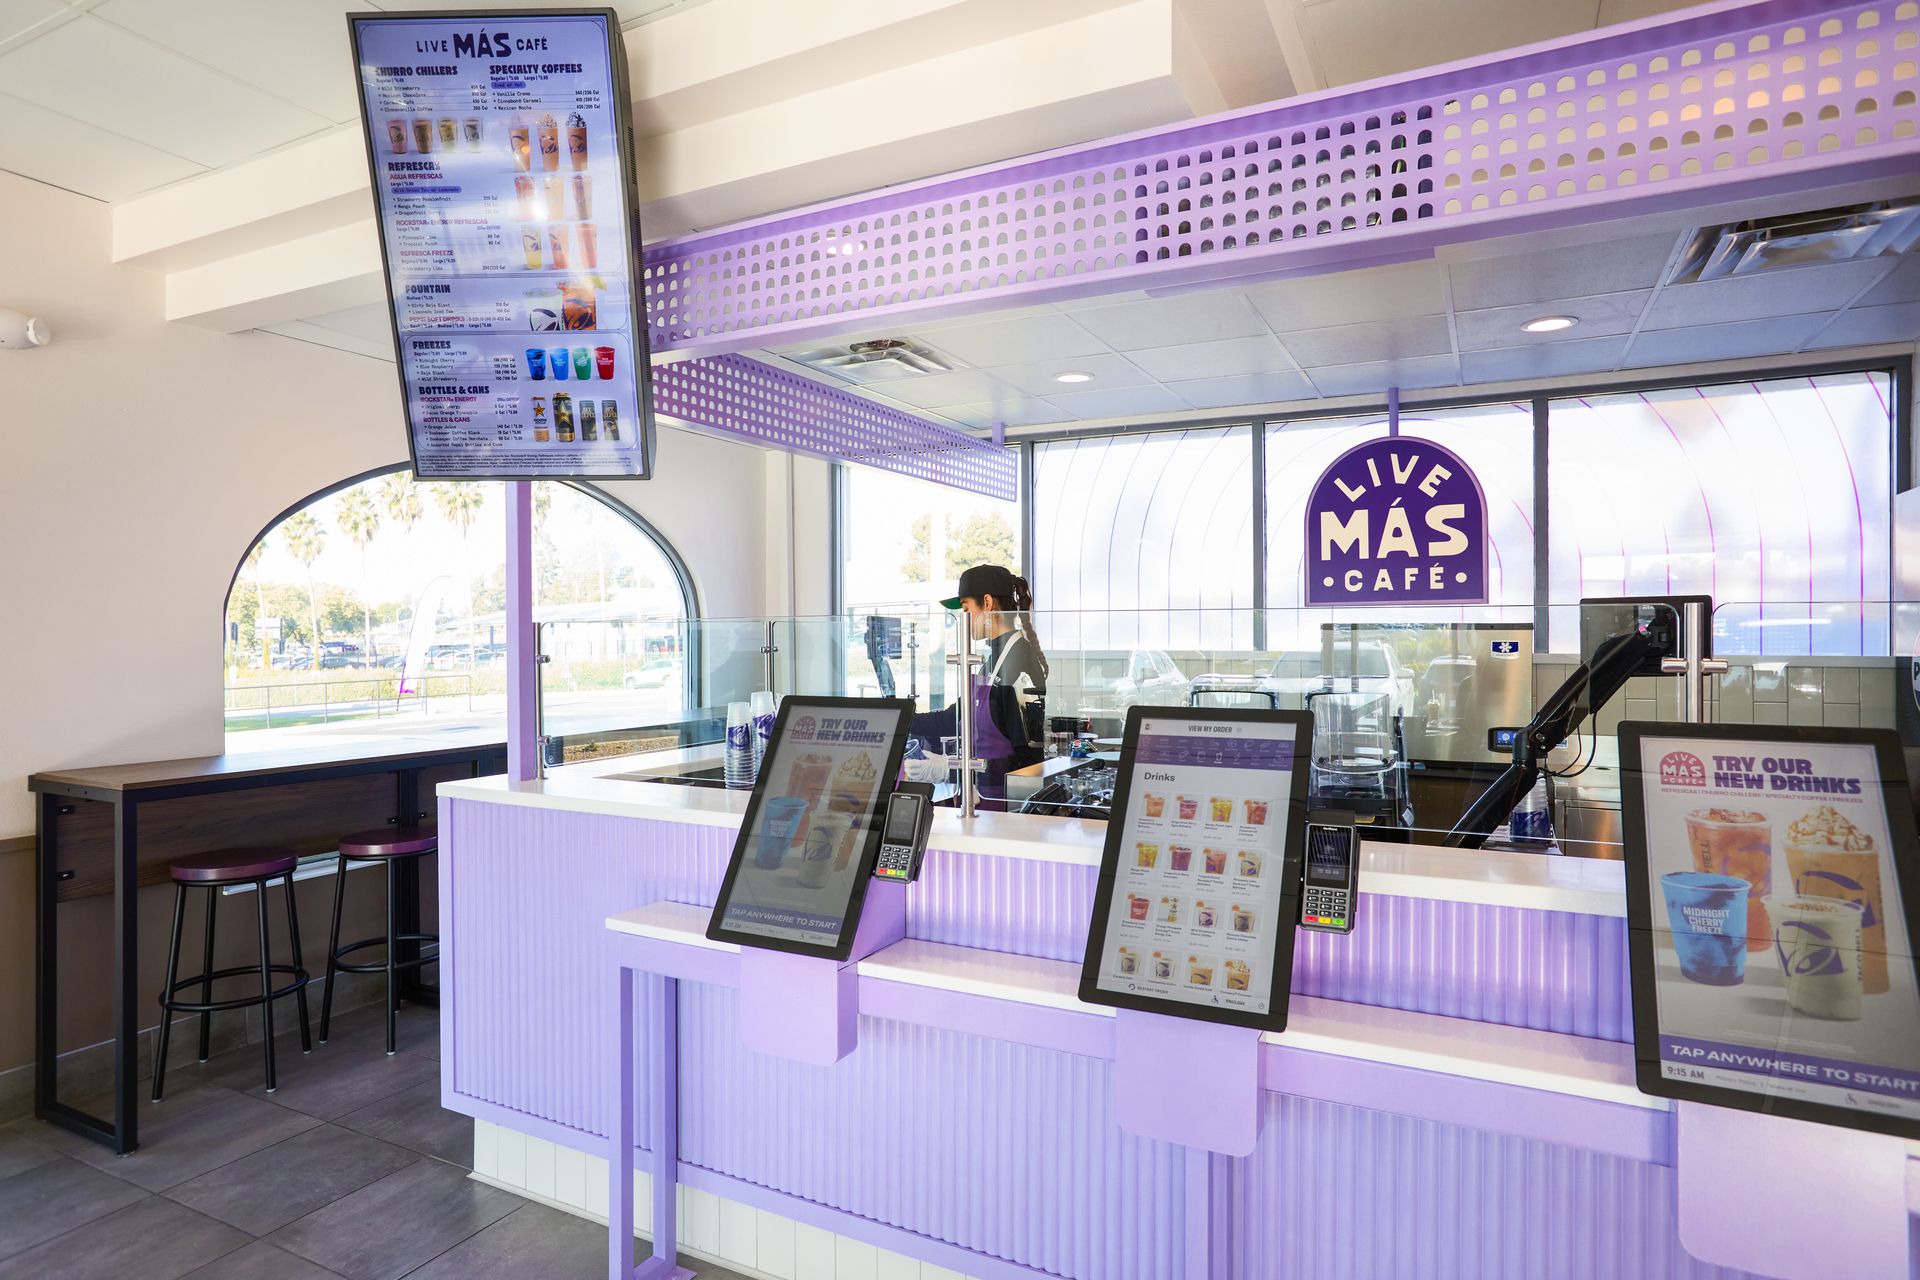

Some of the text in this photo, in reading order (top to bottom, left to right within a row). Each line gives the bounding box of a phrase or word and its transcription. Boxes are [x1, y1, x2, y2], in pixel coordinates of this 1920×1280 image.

[416, 28, 548, 58] LIVE MÁS CAFÉ
[376, 65, 458, 76] CHURRO CHILLERS
[489, 63, 583, 75] SPECIALTY COFFEES
[388, 162, 440, 171] REFRESCAS
[405, 284, 451, 294] FOUNTAIN
[412, 340, 451, 350] FREEZES
[418, 386, 490, 395] BOTTLES & CANS
[1333, 453, 1453, 503] LIVE
[1320, 496, 1469, 561] MÁS
[1344, 562, 1444, 592] CAFÉ
[821, 718, 842, 729] TRY
[843, 719, 868, 730] OUR
[816, 730, 842, 741] NEW
[842, 731, 886, 743] DRINKS
[1667, 753, 1697, 764] LIVE
[1712, 755, 1813, 775] TRY OUR
[1144, 771, 1176, 782] Drinks
[1714, 772, 1862, 795] NEW DRINKS
[1702, 840, 1713, 868] BELL
[731, 907, 837, 929] TAP ANYWHERE TO START
[1683, 906, 1730, 918] MIDNIGHT
[1688, 916, 1725, 927] CHERRY
[1691, 925, 1724, 935] FREEZE
[1667, 1066, 1705, 1080] 9:15 AM
[1671, 1044, 1920, 1092] TAP ANYWHERE TO START
